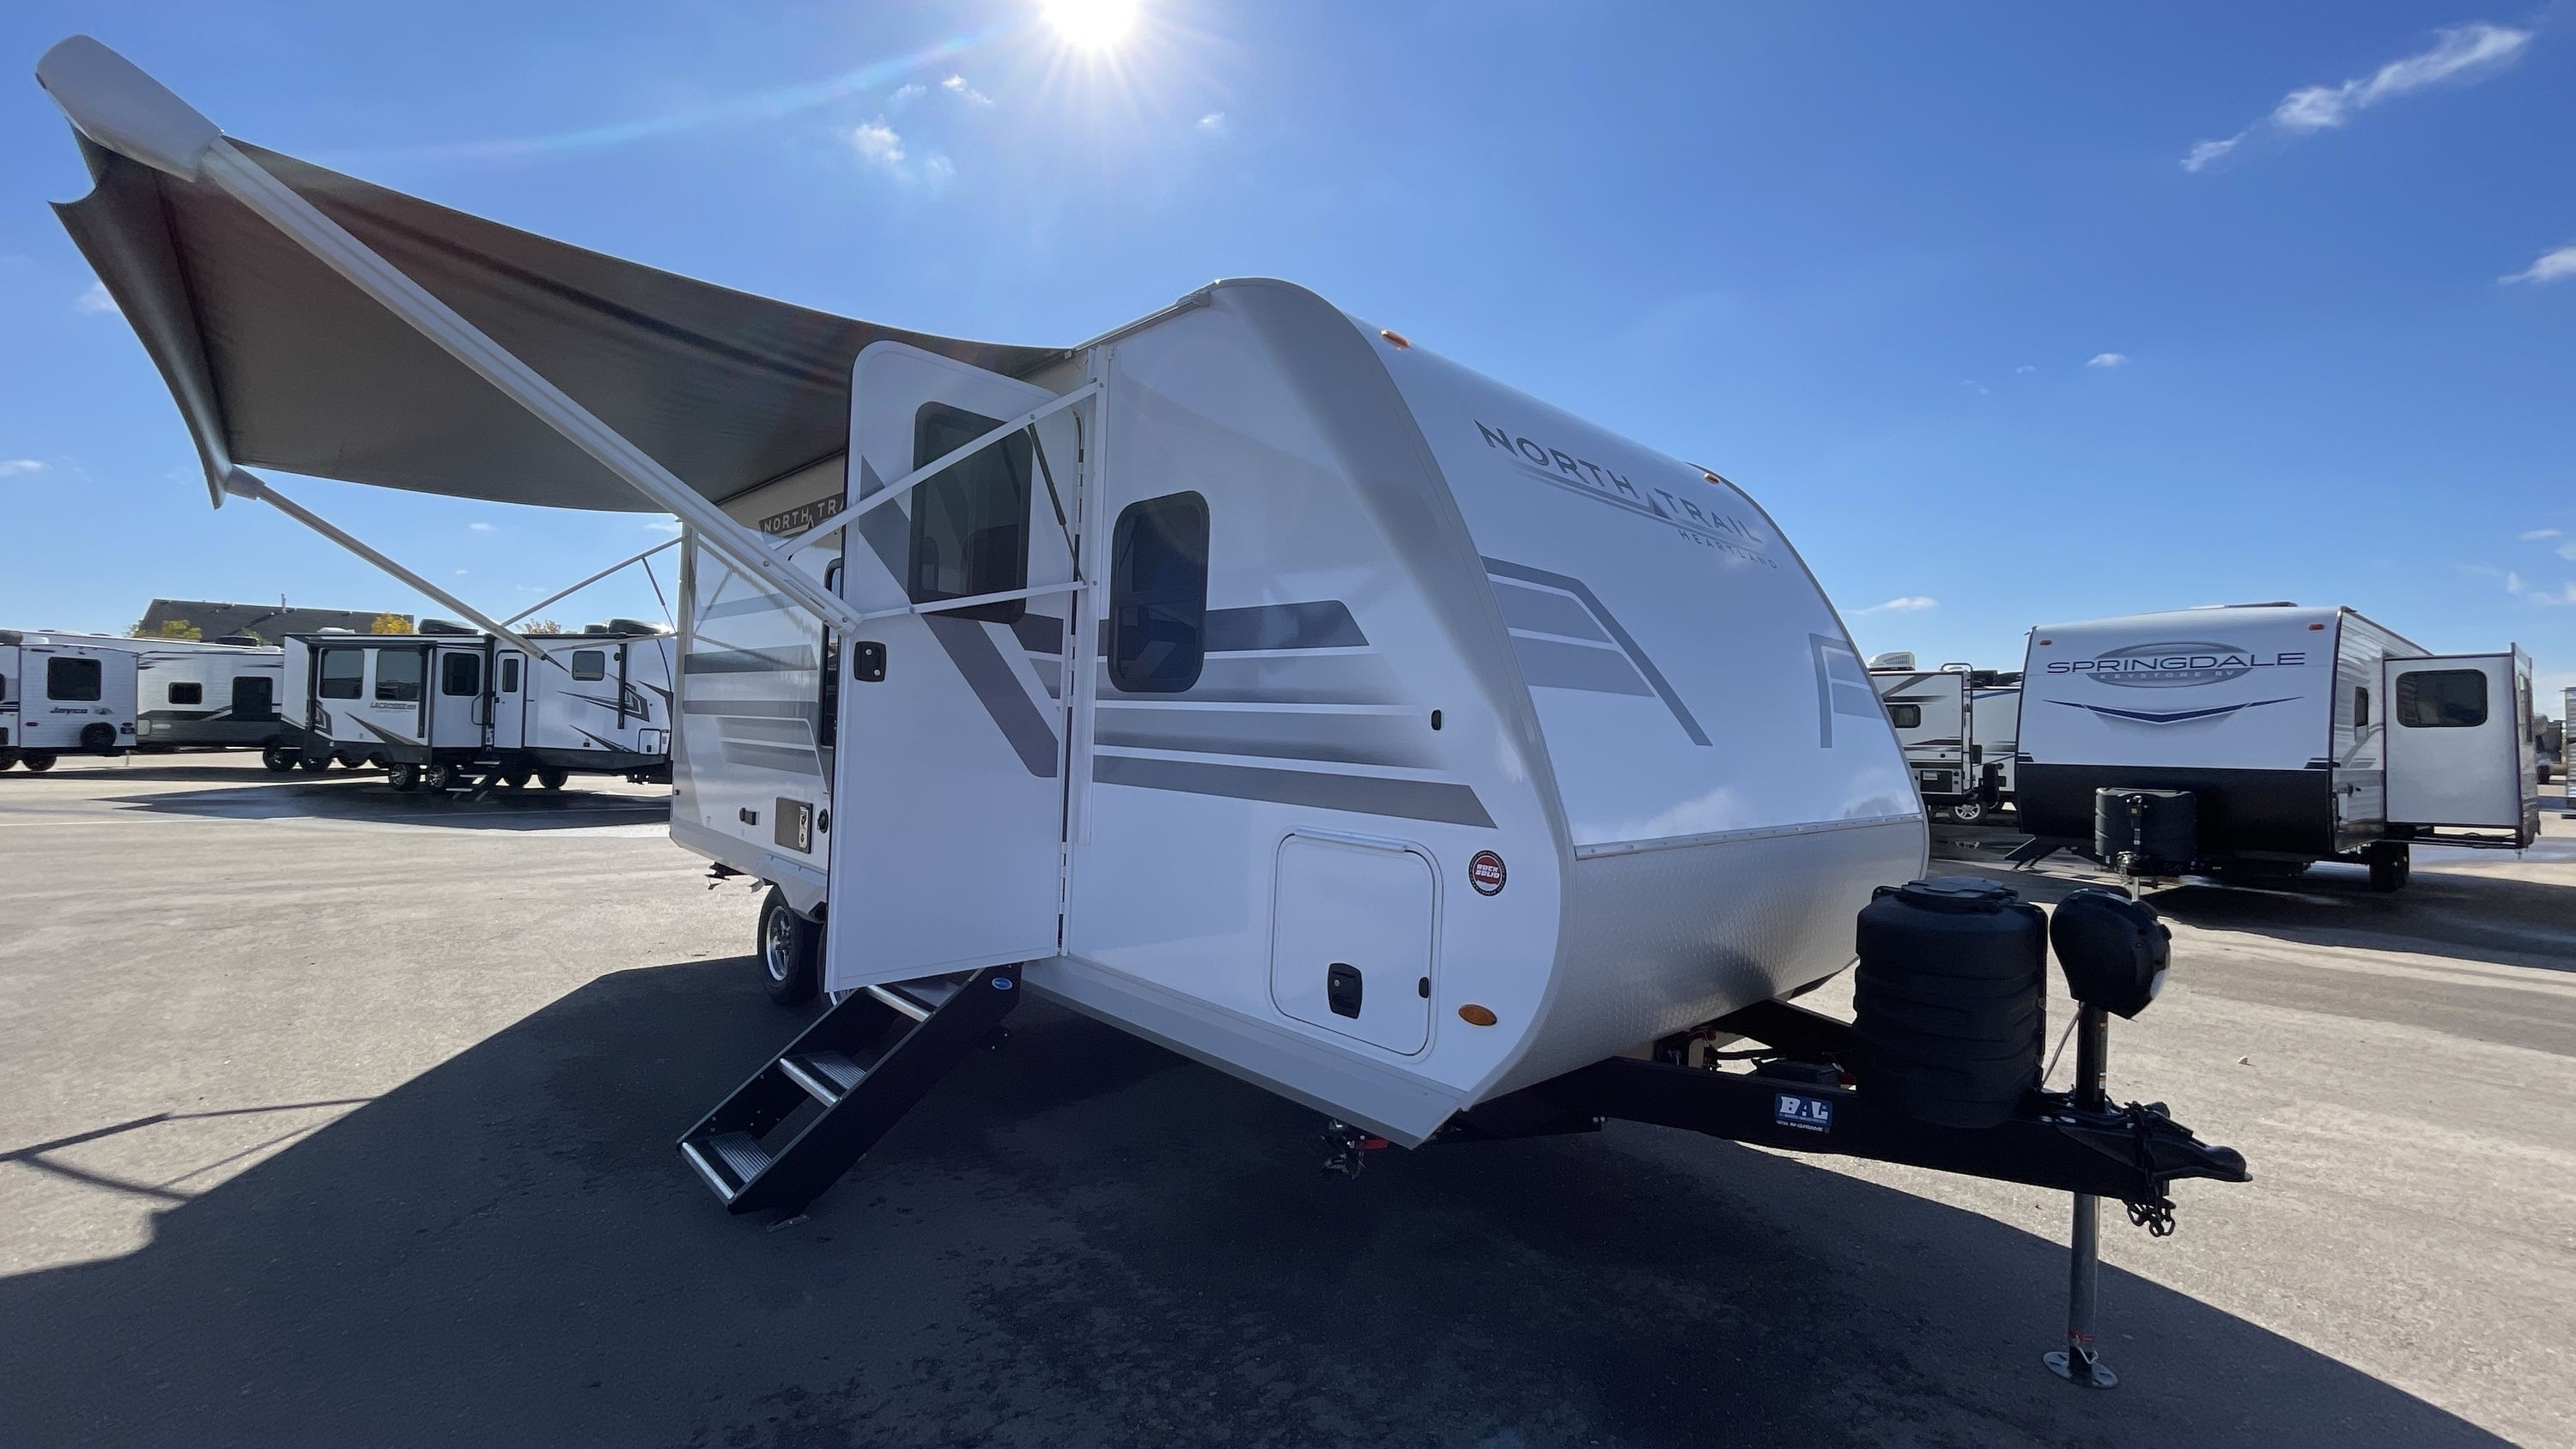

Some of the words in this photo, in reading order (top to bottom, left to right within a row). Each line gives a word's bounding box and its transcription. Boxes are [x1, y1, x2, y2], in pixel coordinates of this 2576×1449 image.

[1473, 419, 1640, 500] NORTH
[1655, 488, 1764, 544] TRAIL
[763, 506, 810, 534] NORTH
[1677, 528, 1777, 569] HEARTLAND
[2046, 652, 2306, 674] SPRINGDALE
[2099, 670, 2202, 680] KEYSTONE
[1475, 870, 1500, 879] SOLID
[1476, 864, 1499, 872] ROCK
